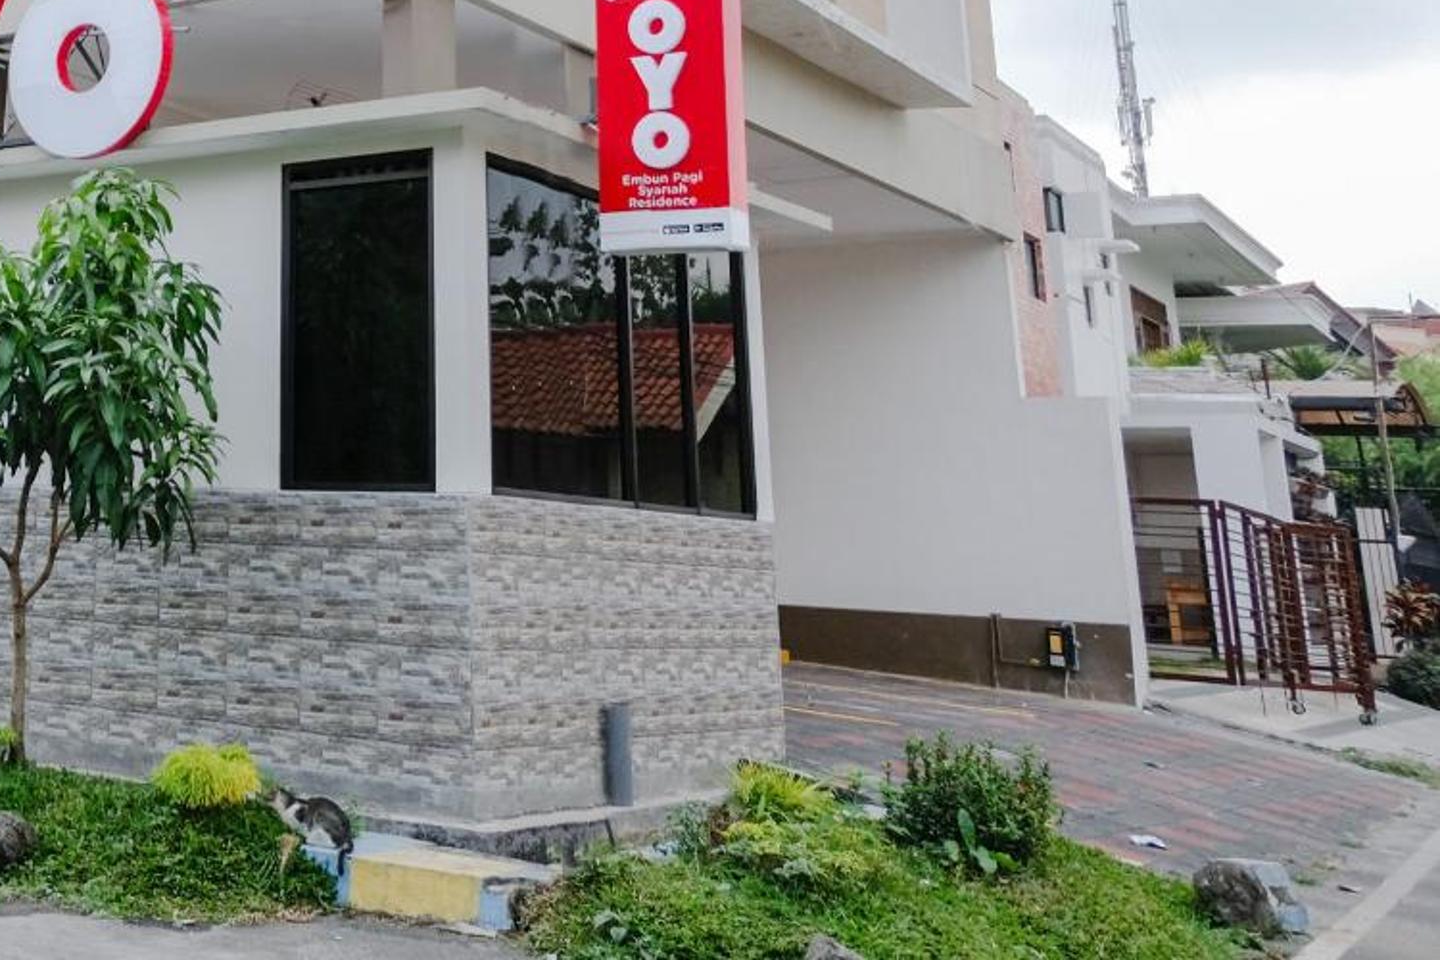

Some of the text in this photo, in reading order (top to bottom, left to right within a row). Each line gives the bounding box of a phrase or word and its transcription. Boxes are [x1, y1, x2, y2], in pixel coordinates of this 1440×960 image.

[622, 169, 704, 186] Embun Pagi
[638, 183, 689, 197] Syariah
[629, 196, 699, 208] Residence
